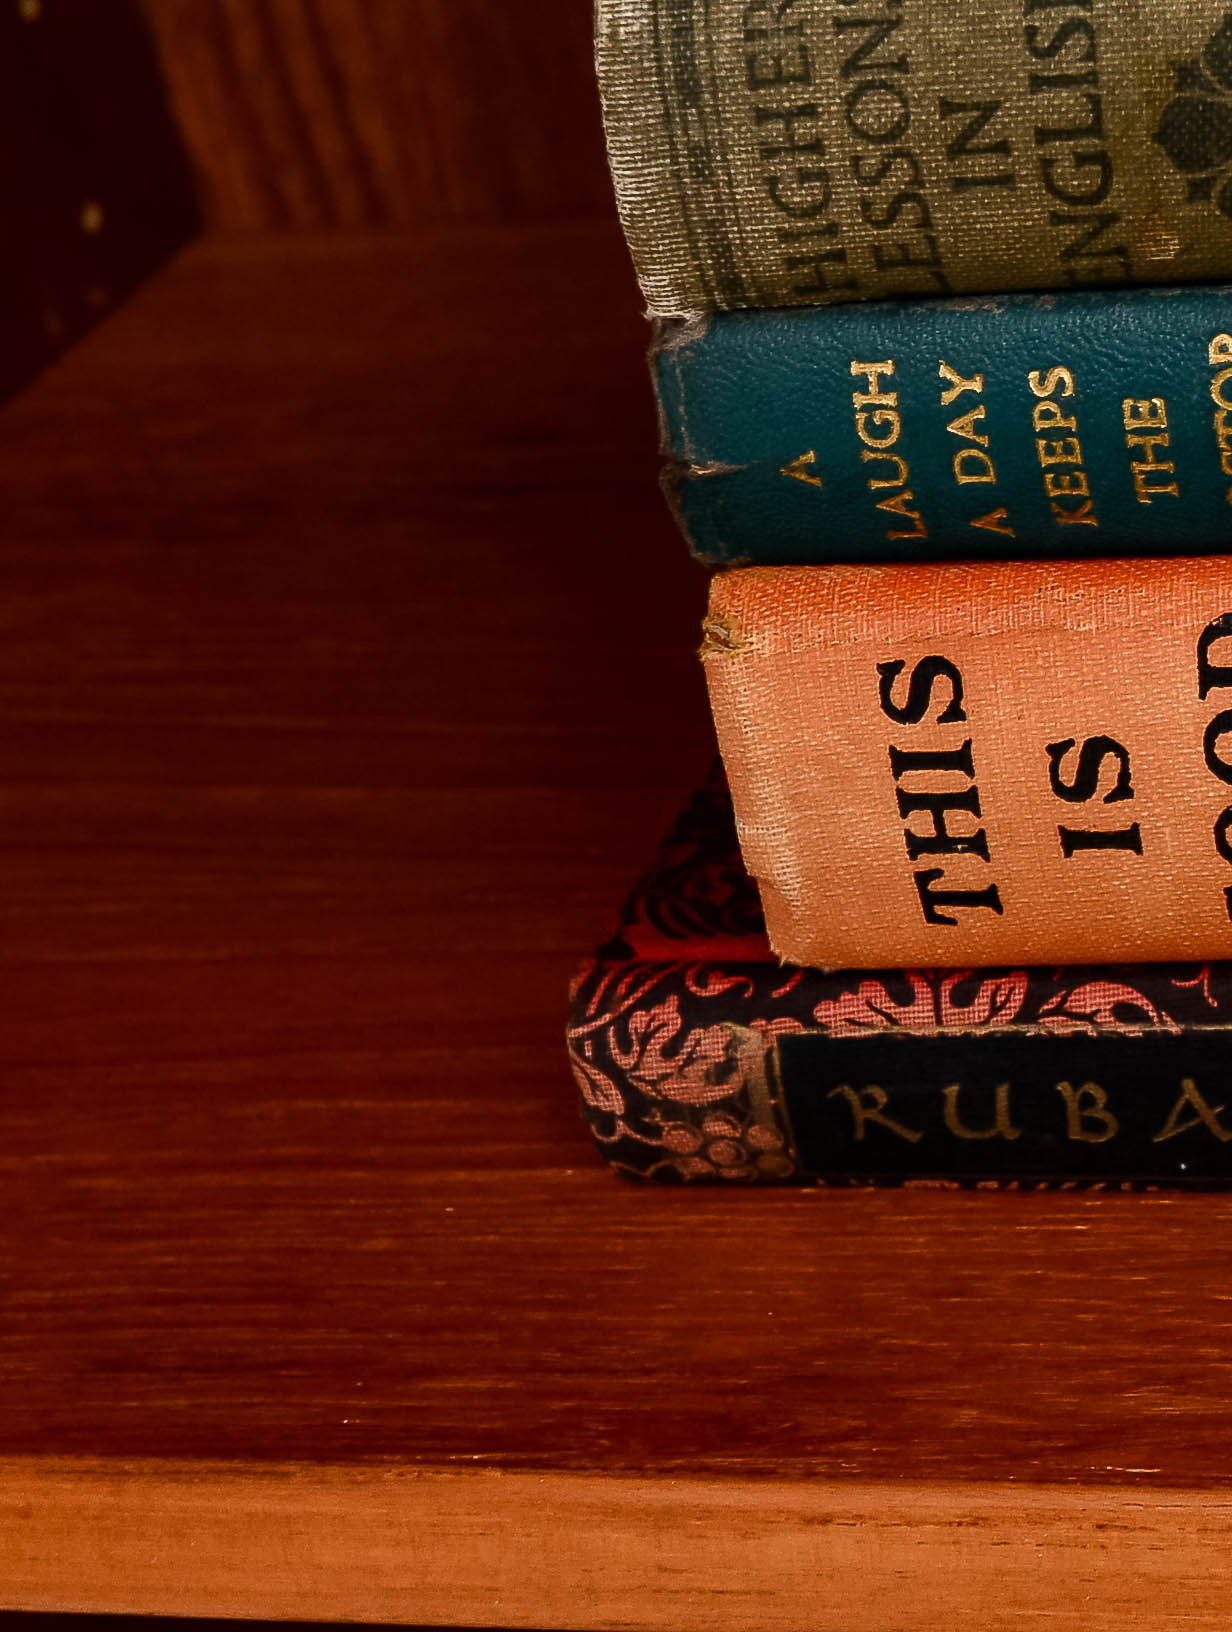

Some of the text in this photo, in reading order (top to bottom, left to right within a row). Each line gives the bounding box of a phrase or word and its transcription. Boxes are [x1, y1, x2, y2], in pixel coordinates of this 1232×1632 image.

[833, 0, 952, 294] ESSON
[938, 98, 1016, 193] IN
[780, 447, 824, 489] A
[849, 358, 930, 541] LAUGH
[937, 359, 1017, 539] A DAY
[1027, 364, 1100, 528] KEEPS
[1121, 396, 1180, 505] THE
[876, 654, 1005, 928] THIS
[1044, 734, 1146, 860] IS
